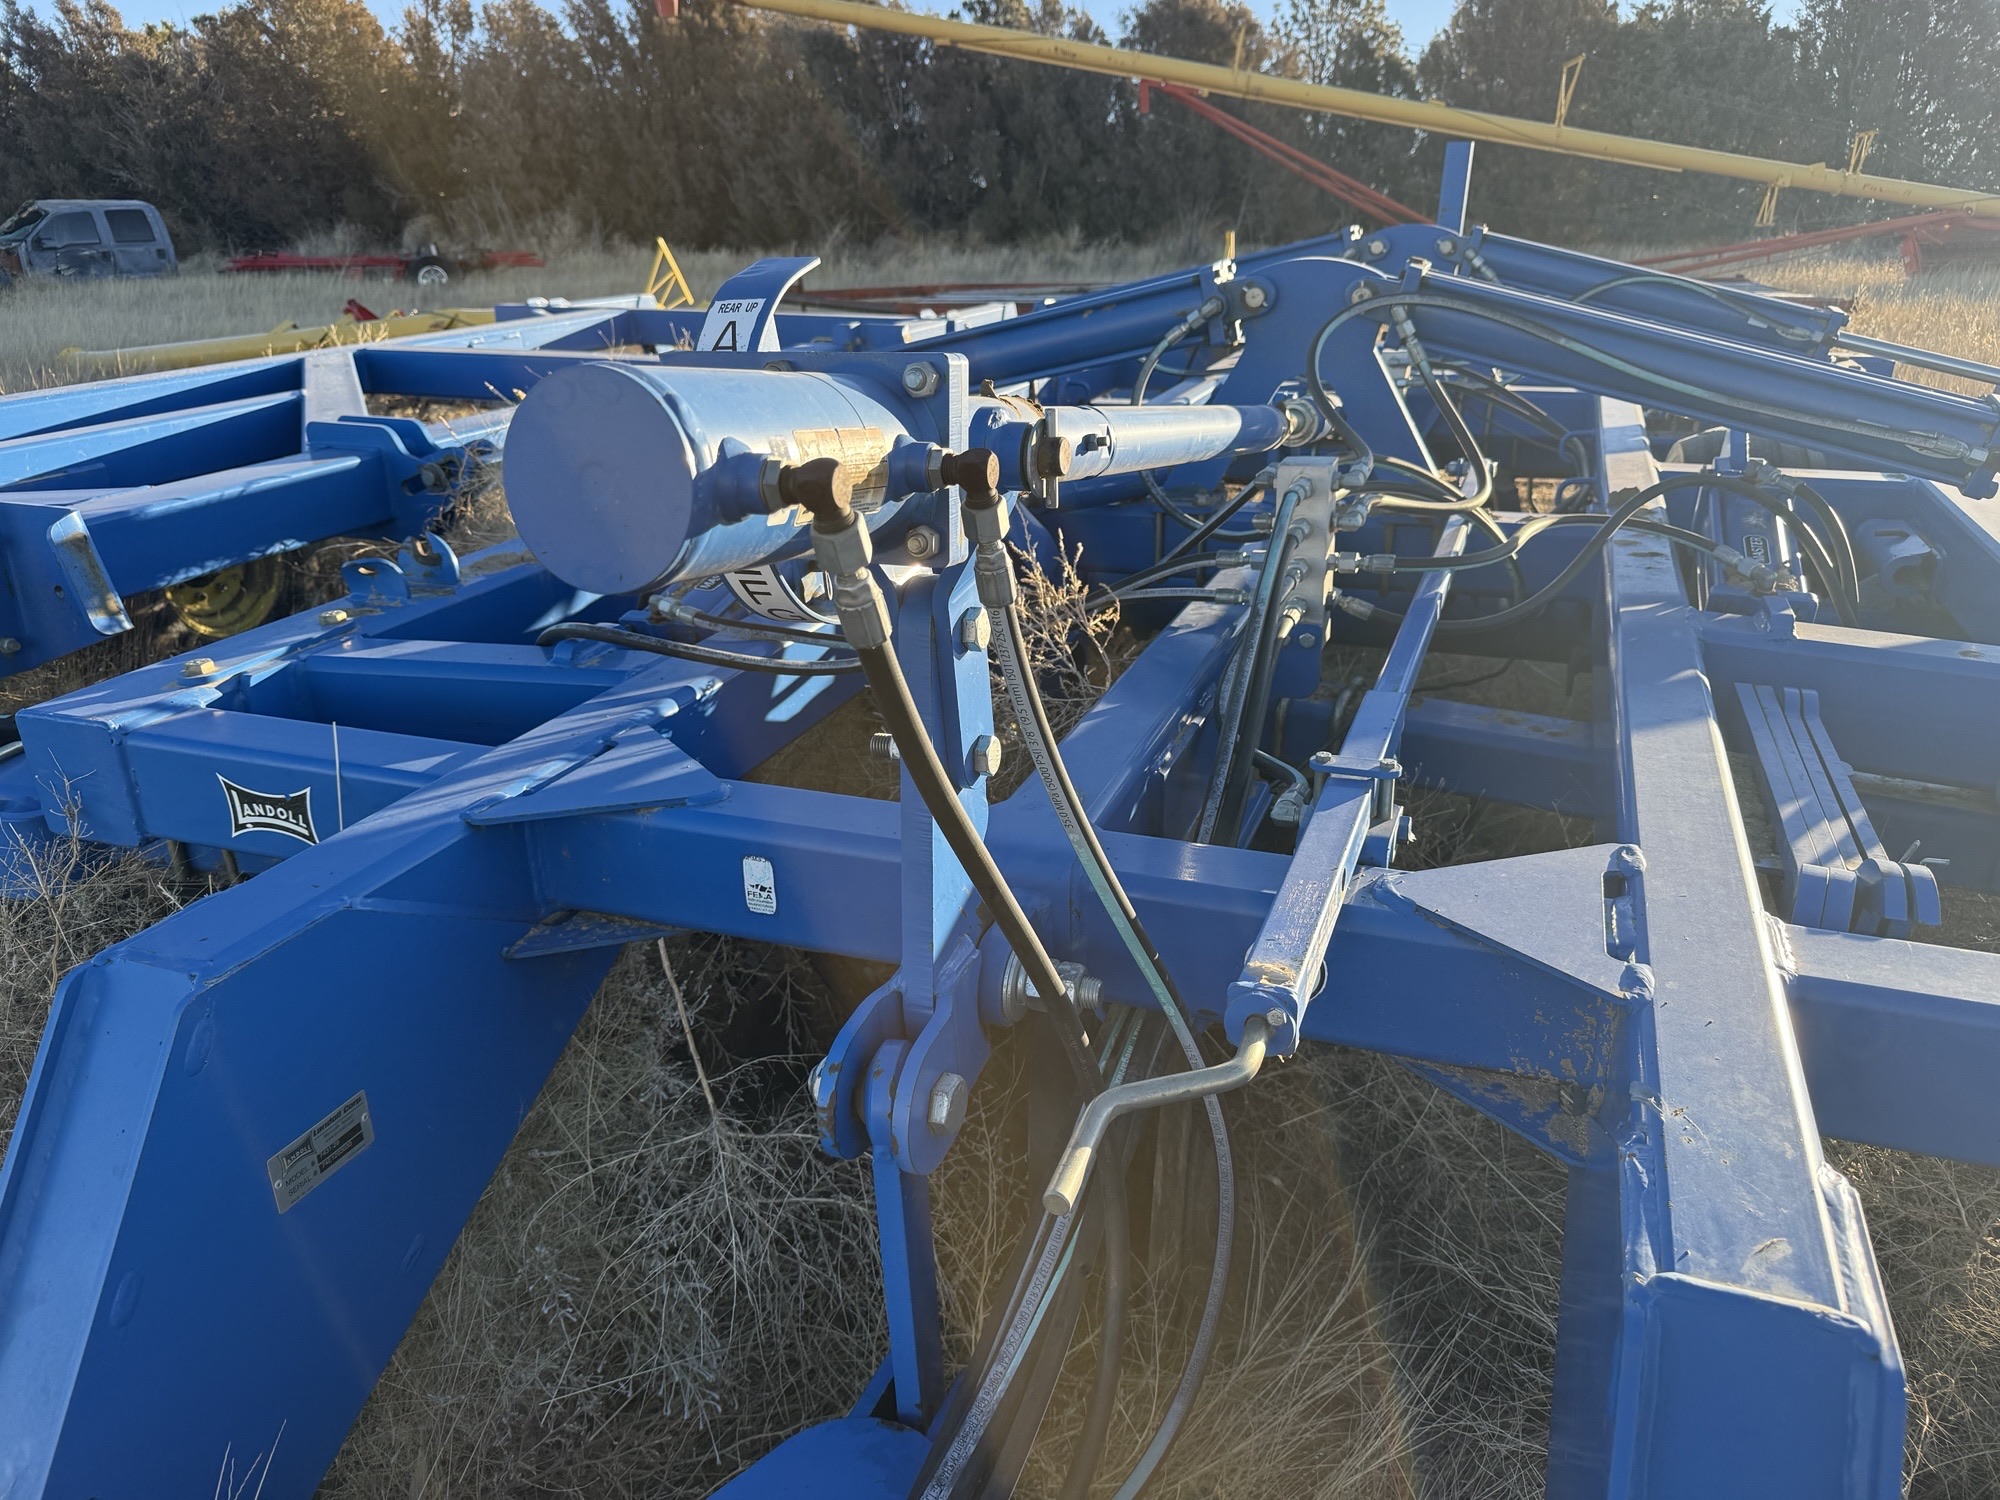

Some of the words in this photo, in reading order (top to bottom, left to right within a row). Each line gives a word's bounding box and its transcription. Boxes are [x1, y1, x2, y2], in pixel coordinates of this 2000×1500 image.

[718, 302, 742, 314] REAR
[745, 302, 758, 313] UP
[712, 320, 738, 352] A
[992, 610, 1000, 626] R16
[996, 628, 1004, 642] 2SC
[1009, 683, 1024, 706] mm)
[1017, 708, 1032, 726] (9.5
[1033, 748, 1046, 765] PSI)
[1039, 766, 1057, 791] (5000
[1052, 793, 1065, 810] MPa
[230, 789, 310, 836] LANDOLL
[1059, 812, 1073, 828] 35.0
[285, 1166, 310, 1187] MODEL
[288, 1176, 312, 1196] SERIAL
[1052, 1222, 1066, 1244] mm)
[1032, 1276, 1044, 1291] 2SC
[1026, 1290, 1038, 1305] R16
[1014, 1311, 1030, 1335] EN857
[1006, 1334, 1019, 1351] 2SC
[997, 1353, 1011, 1371] SAE
